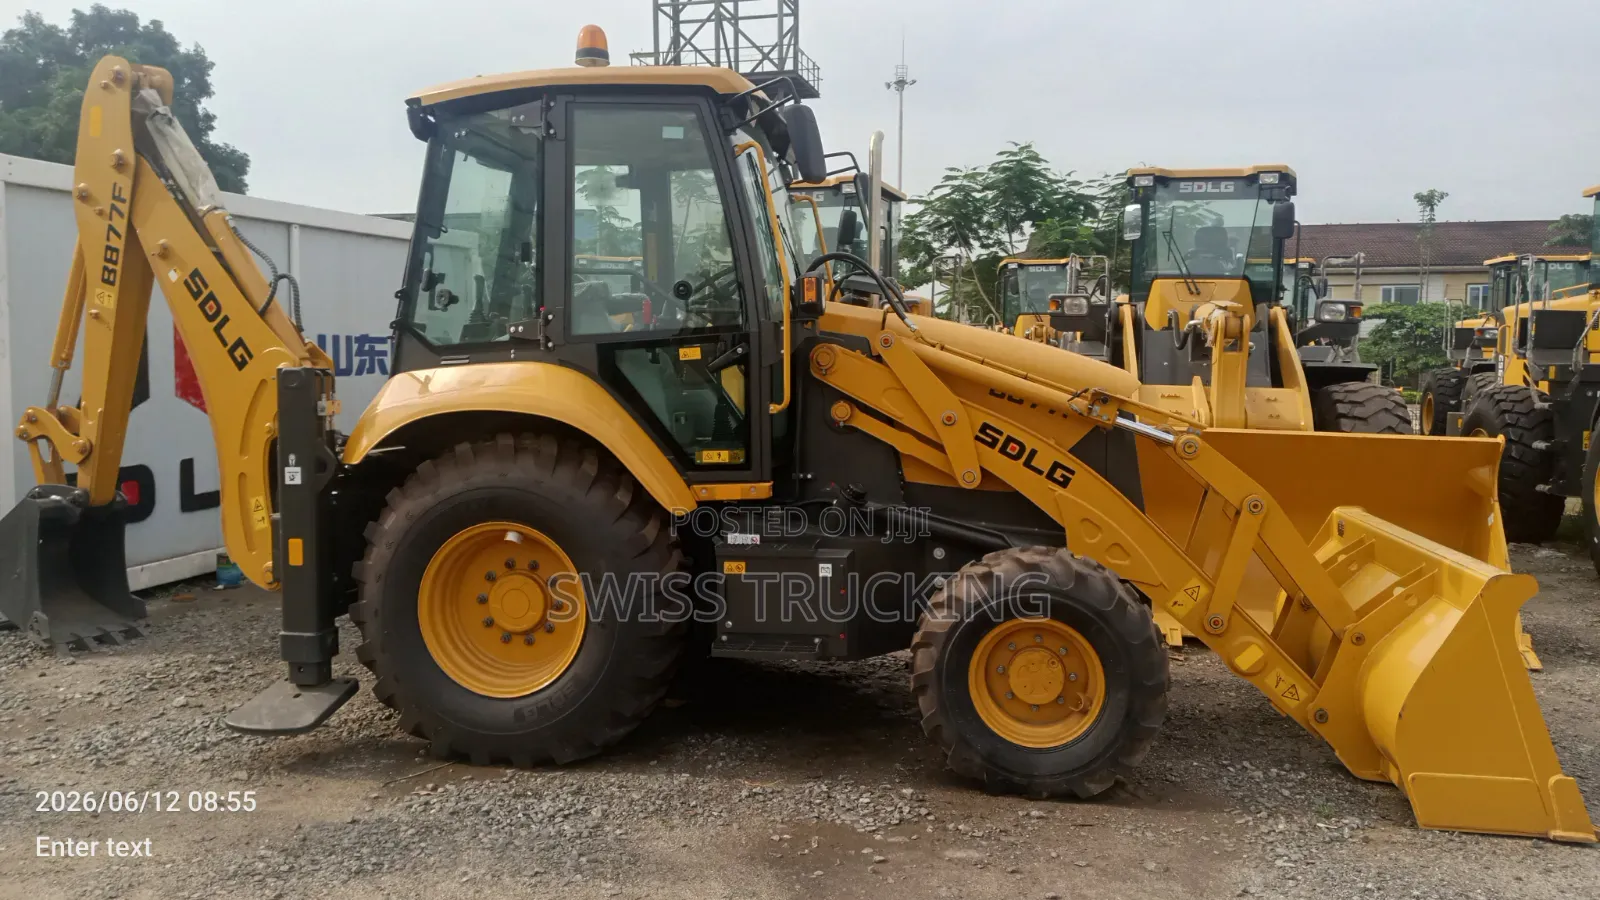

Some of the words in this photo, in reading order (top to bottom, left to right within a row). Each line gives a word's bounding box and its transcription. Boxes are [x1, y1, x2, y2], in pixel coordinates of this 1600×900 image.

[1179, 181, 1235, 193] SDLG
[101, 182, 127, 287] B877F
[183, 267, 254, 372] SDLG
[317, 333, 397, 377] 山东
[974, 421, 1076, 489] SDLG
